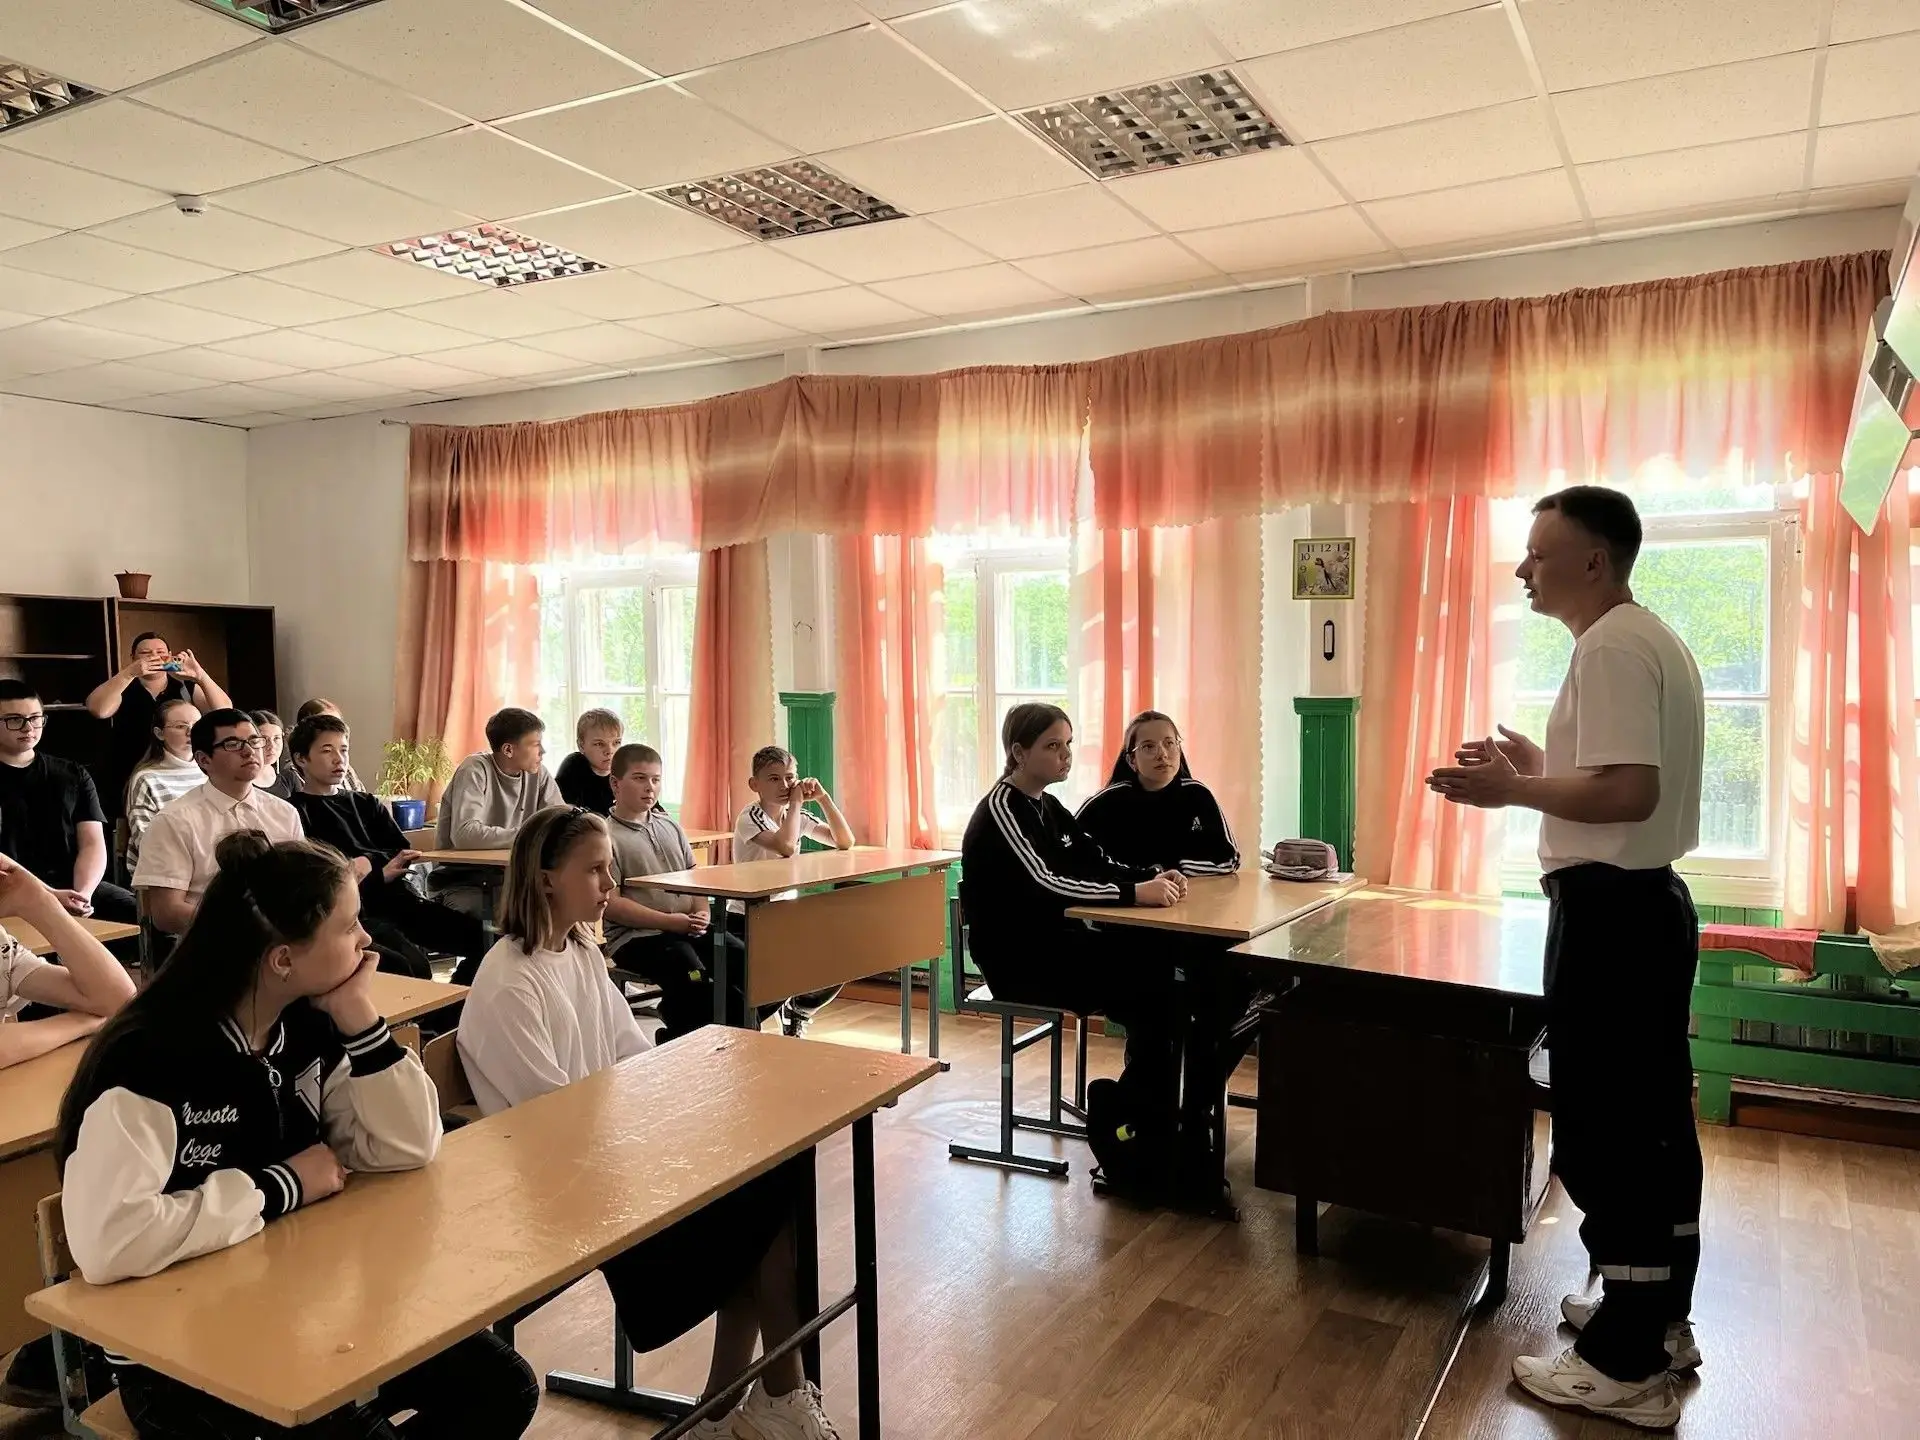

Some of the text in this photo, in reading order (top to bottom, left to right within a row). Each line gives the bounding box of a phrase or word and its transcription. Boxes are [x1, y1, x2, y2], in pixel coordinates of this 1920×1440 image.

[1307, 544, 1315, 553] 11
[1321, 544, 1332, 552] 12
[1301, 552, 1311, 561] 10
[1344, 552, 1350, 560] 2
